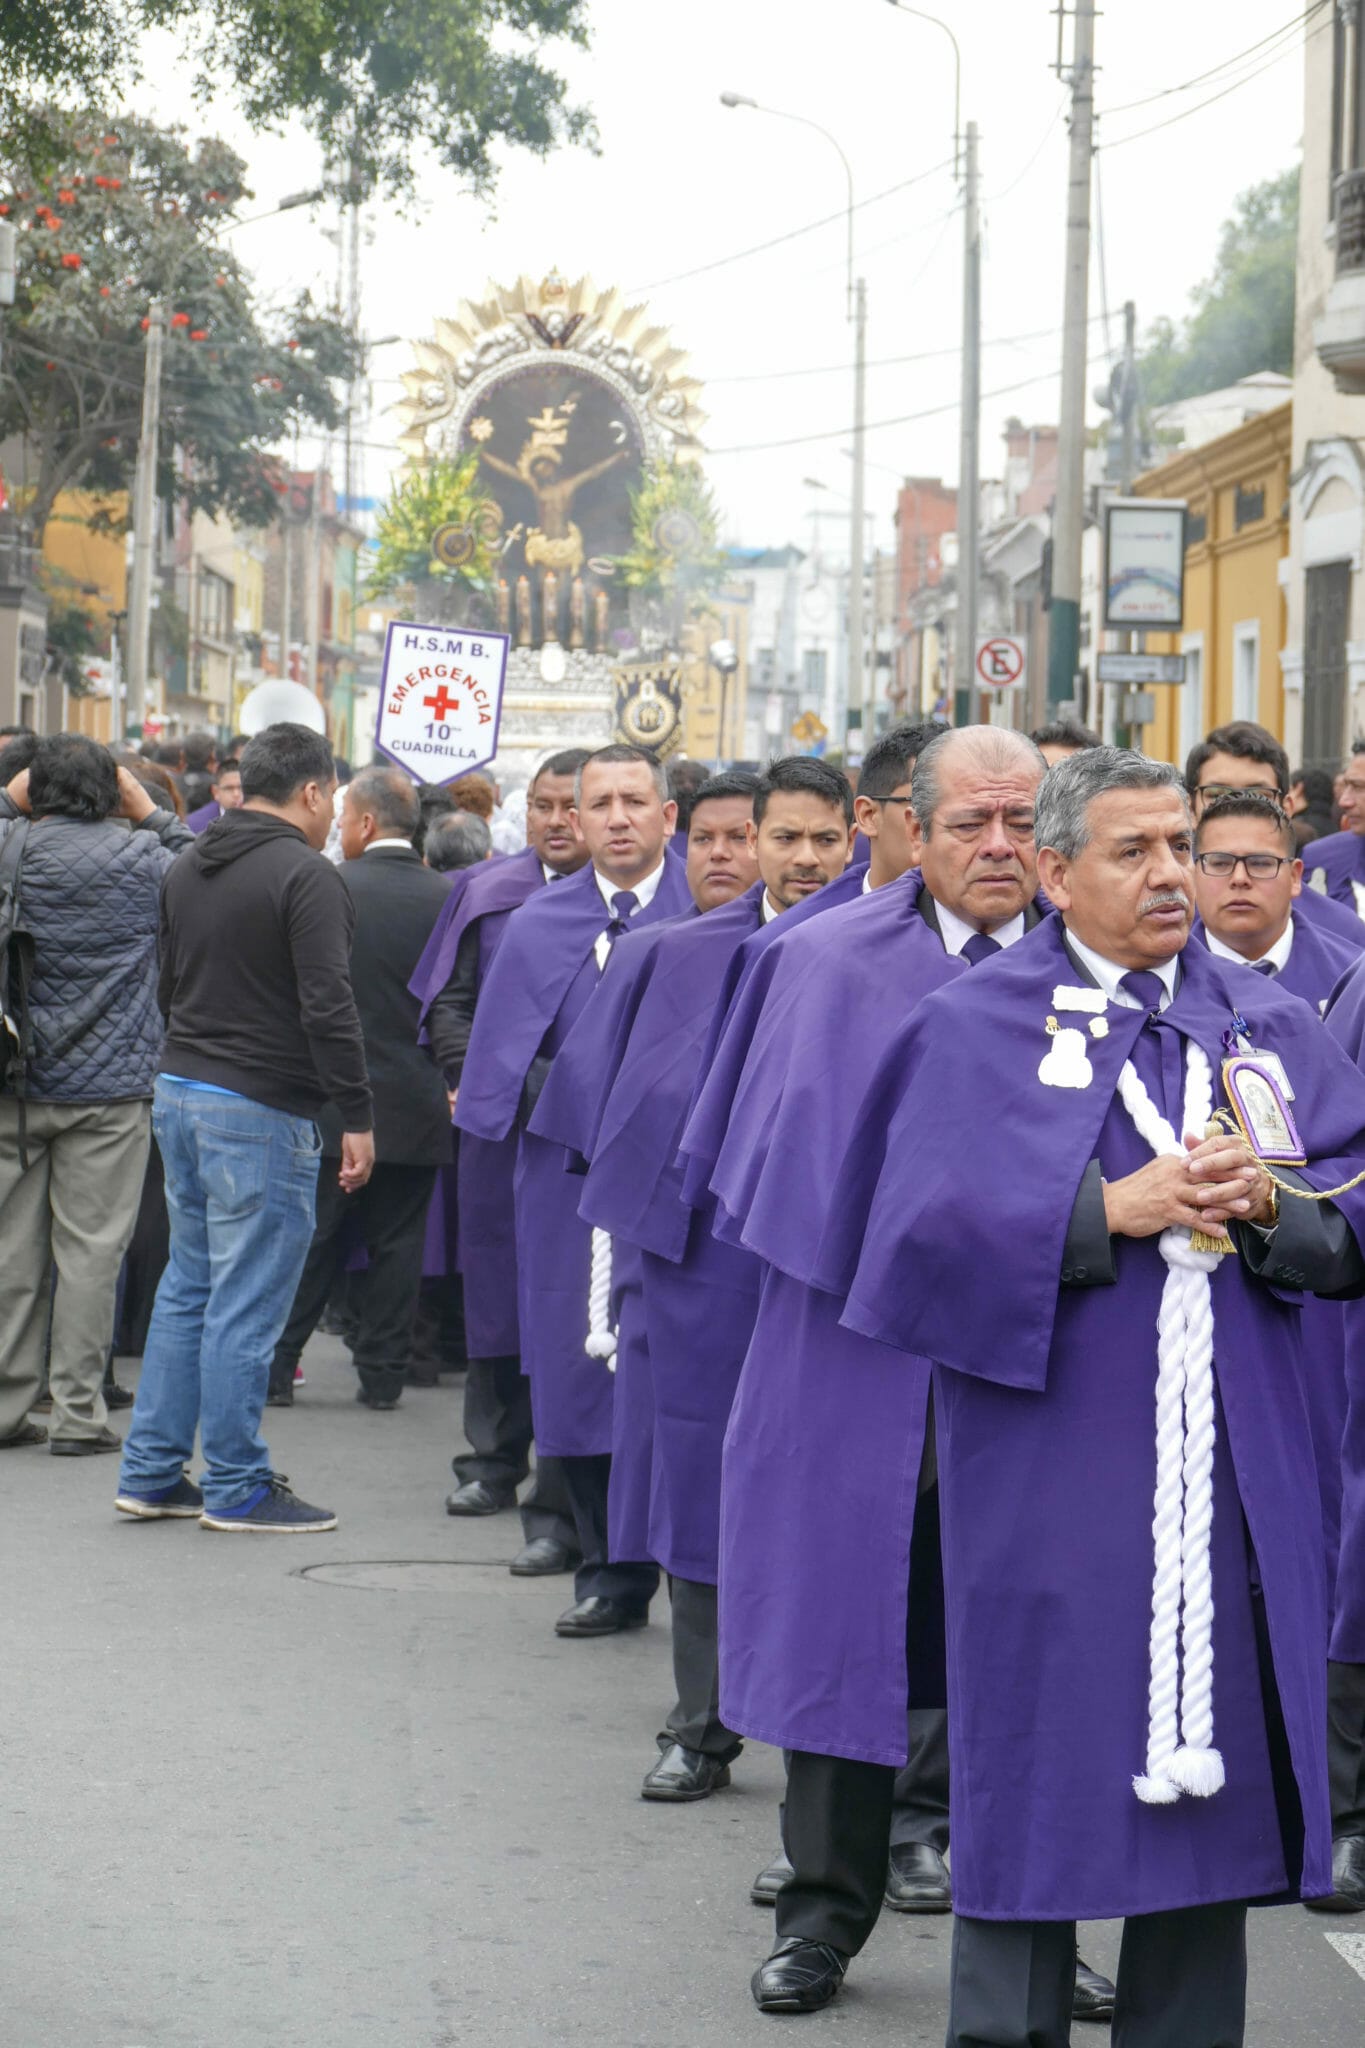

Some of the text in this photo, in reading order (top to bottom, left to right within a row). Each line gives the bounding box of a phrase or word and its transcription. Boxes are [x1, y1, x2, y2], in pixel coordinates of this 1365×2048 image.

[991, 649, 1010, 675] E
[388, 664, 492, 725] EMERGENCIA
[391, 740, 477, 759] CUADRILLA
